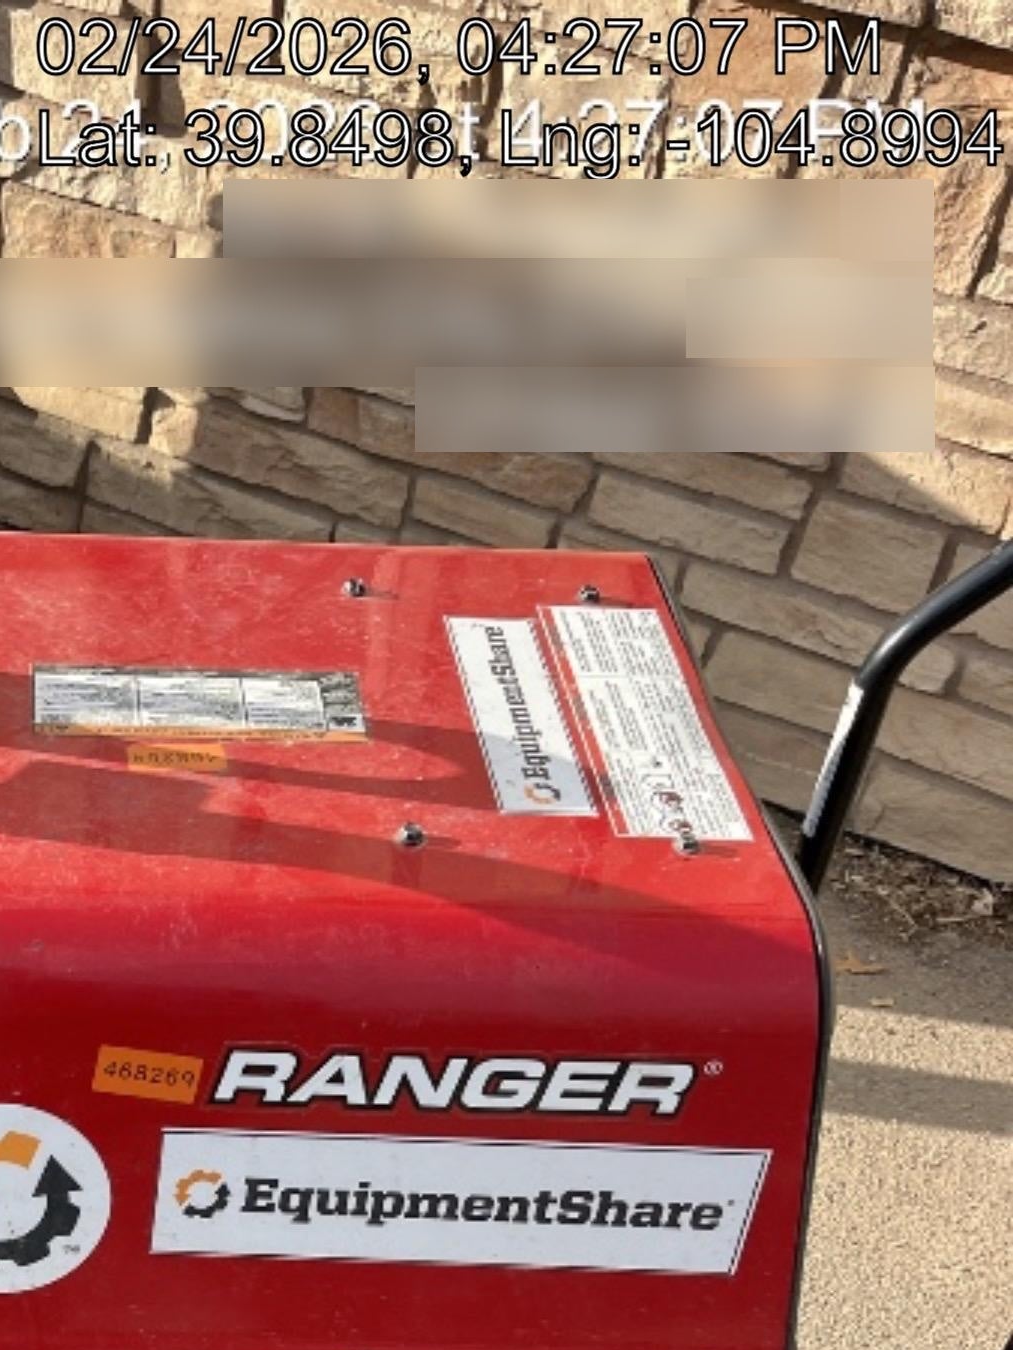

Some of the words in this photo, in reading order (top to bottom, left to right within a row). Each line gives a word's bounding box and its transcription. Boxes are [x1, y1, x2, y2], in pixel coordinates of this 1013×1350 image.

[484, 624, 552, 781] EquipmentShare
[102, 1059, 196, 1088] 468269
[213, 1049, 694, 1115] RANGER
[240, 1177, 724, 1231] EquipmentShare
